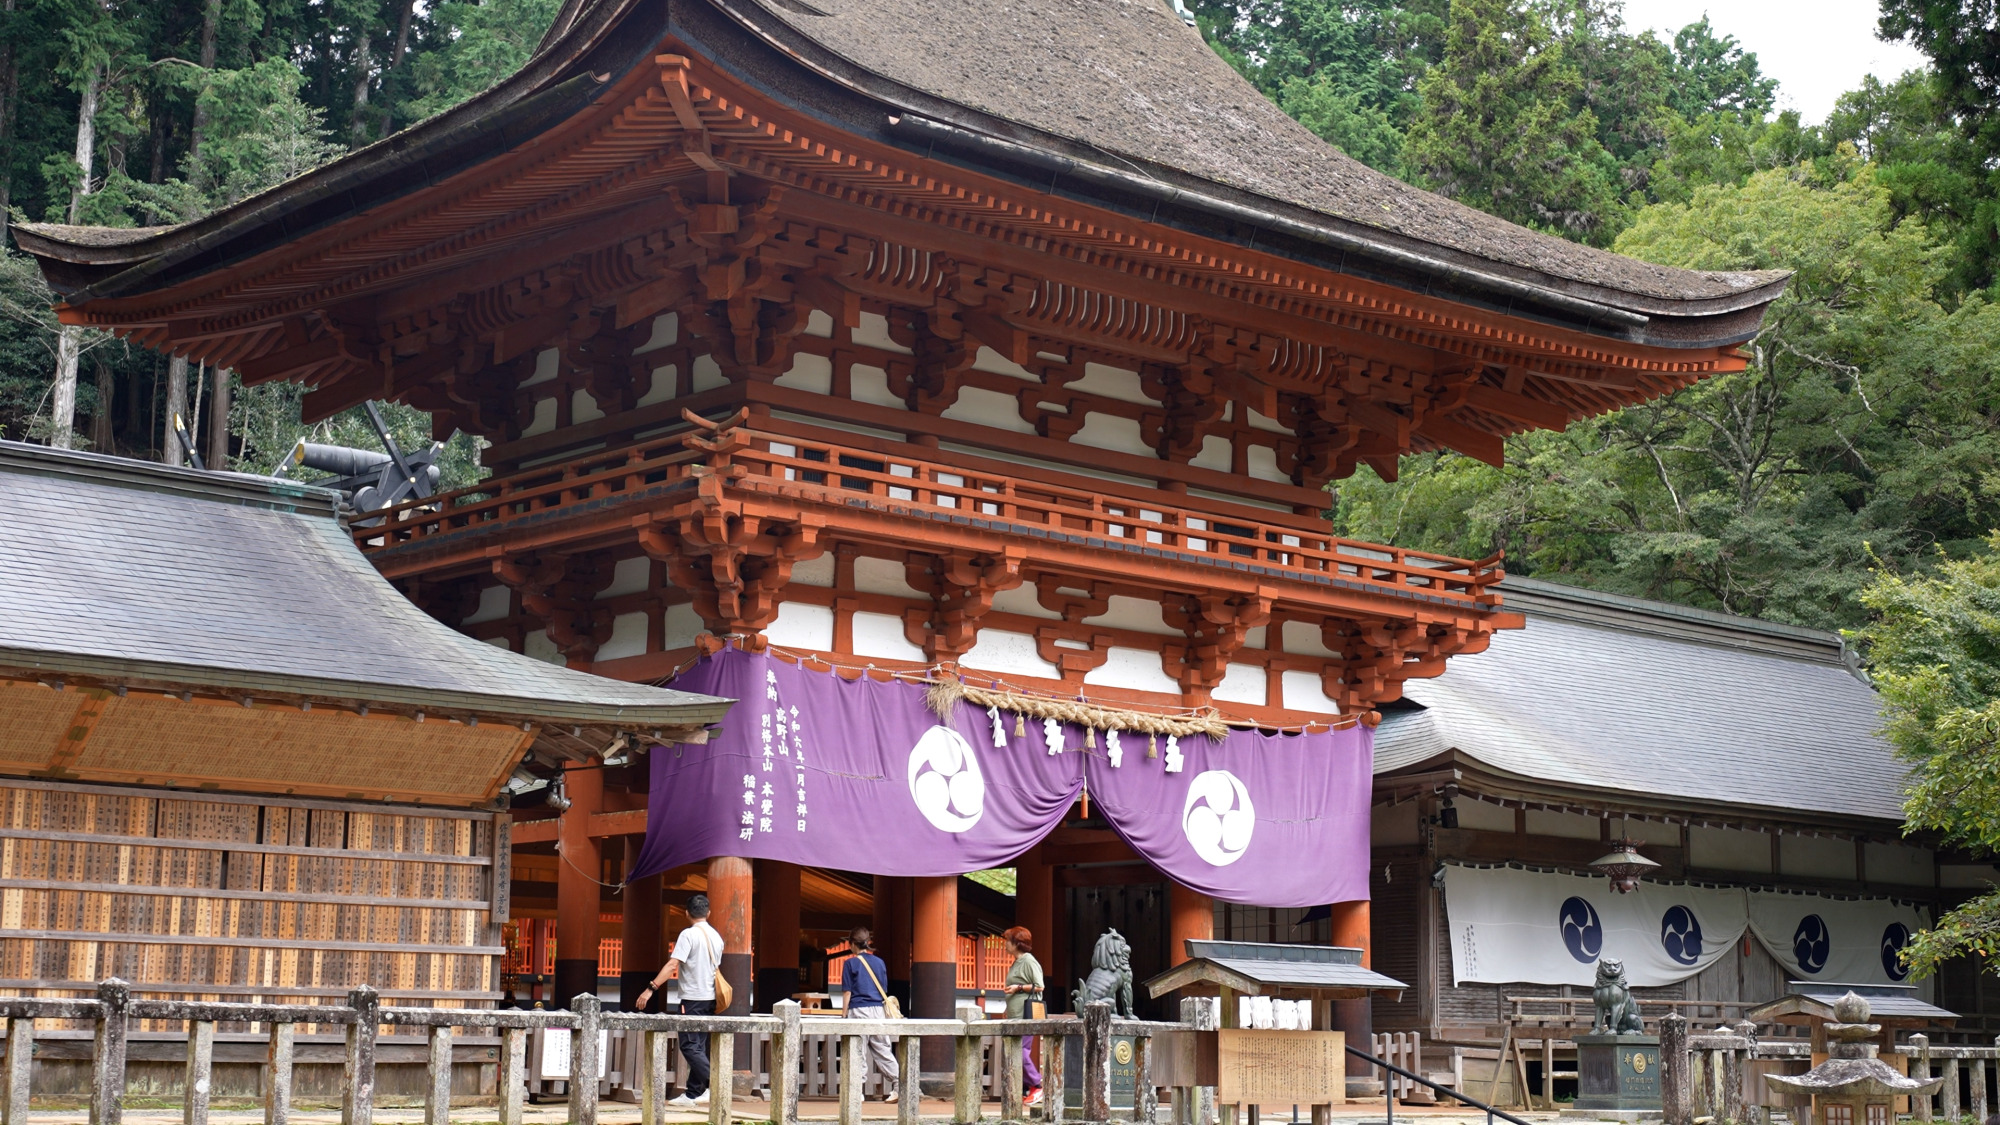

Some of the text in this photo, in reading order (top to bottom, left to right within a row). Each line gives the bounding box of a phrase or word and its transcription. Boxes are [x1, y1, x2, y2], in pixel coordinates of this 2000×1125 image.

[766, 669, 777, 702] 奉納
[760, 714, 774, 832] 別格本山 本覺院
[776, 707, 789, 757] 高野山
[790, 705, 808, 832] 令和六年一月吉祥日
